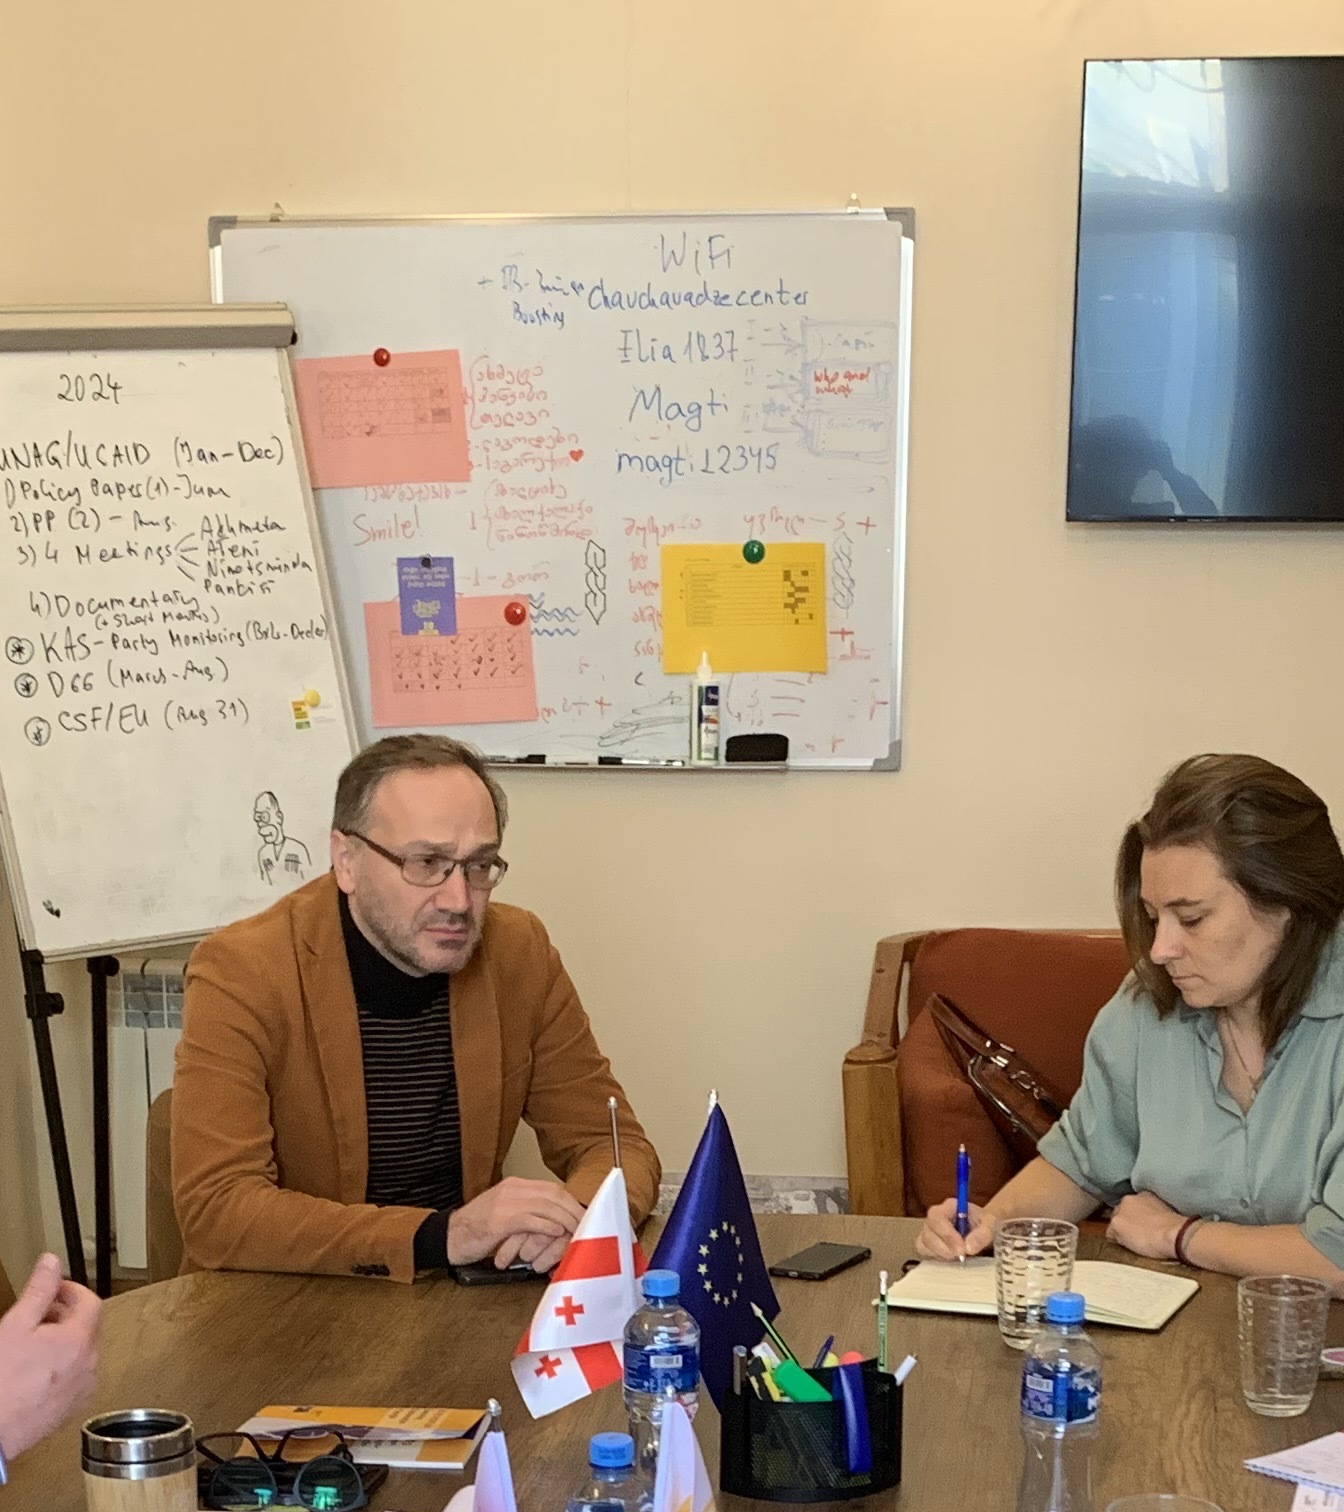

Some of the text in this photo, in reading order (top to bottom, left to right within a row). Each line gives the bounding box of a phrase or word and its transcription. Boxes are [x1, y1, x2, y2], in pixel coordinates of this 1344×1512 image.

[659, 231, 735, 276] WiFi
[57, 372, 123, 405] 2024
[628, 383, 729, 433] Magti
[20, 475, 82, 506] Policy
[32, 509, 56, 534] PP
[353, 504, 422, 546] Smile!
[76, 540, 173, 566] Meetings
[54, 589, 200, 618] Documentary
[40, 625, 91, 664] KAS
[111, 631, 159, 656] Party
[58, 701, 149, 735] CSF/EU
